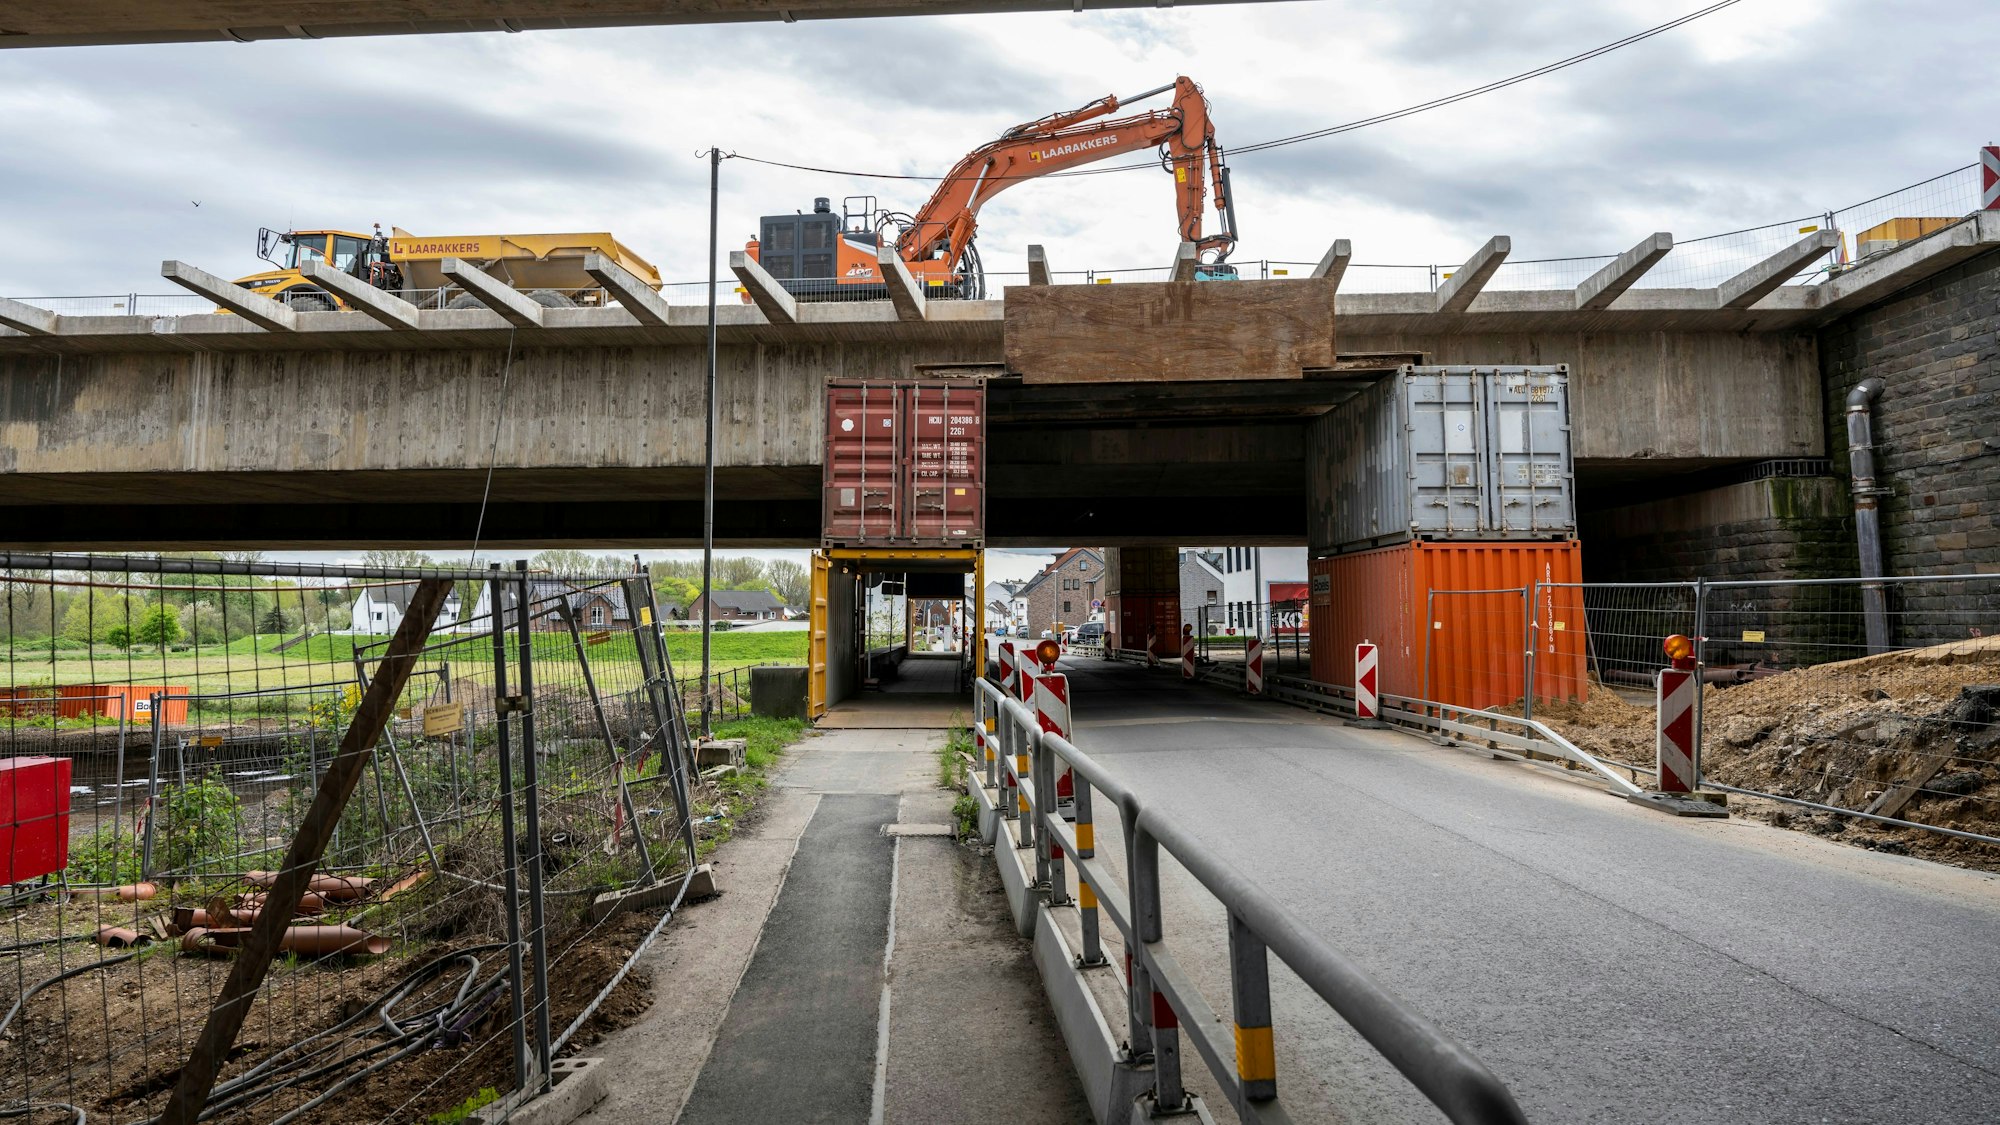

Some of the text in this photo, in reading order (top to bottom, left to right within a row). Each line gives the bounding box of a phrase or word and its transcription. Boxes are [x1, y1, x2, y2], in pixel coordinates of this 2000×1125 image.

[1042, 135, 1118, 159] LAARAKKERS
[409, 243, 480, 254] LAARAKKERS
[950, 416, 973, 424] 204386
